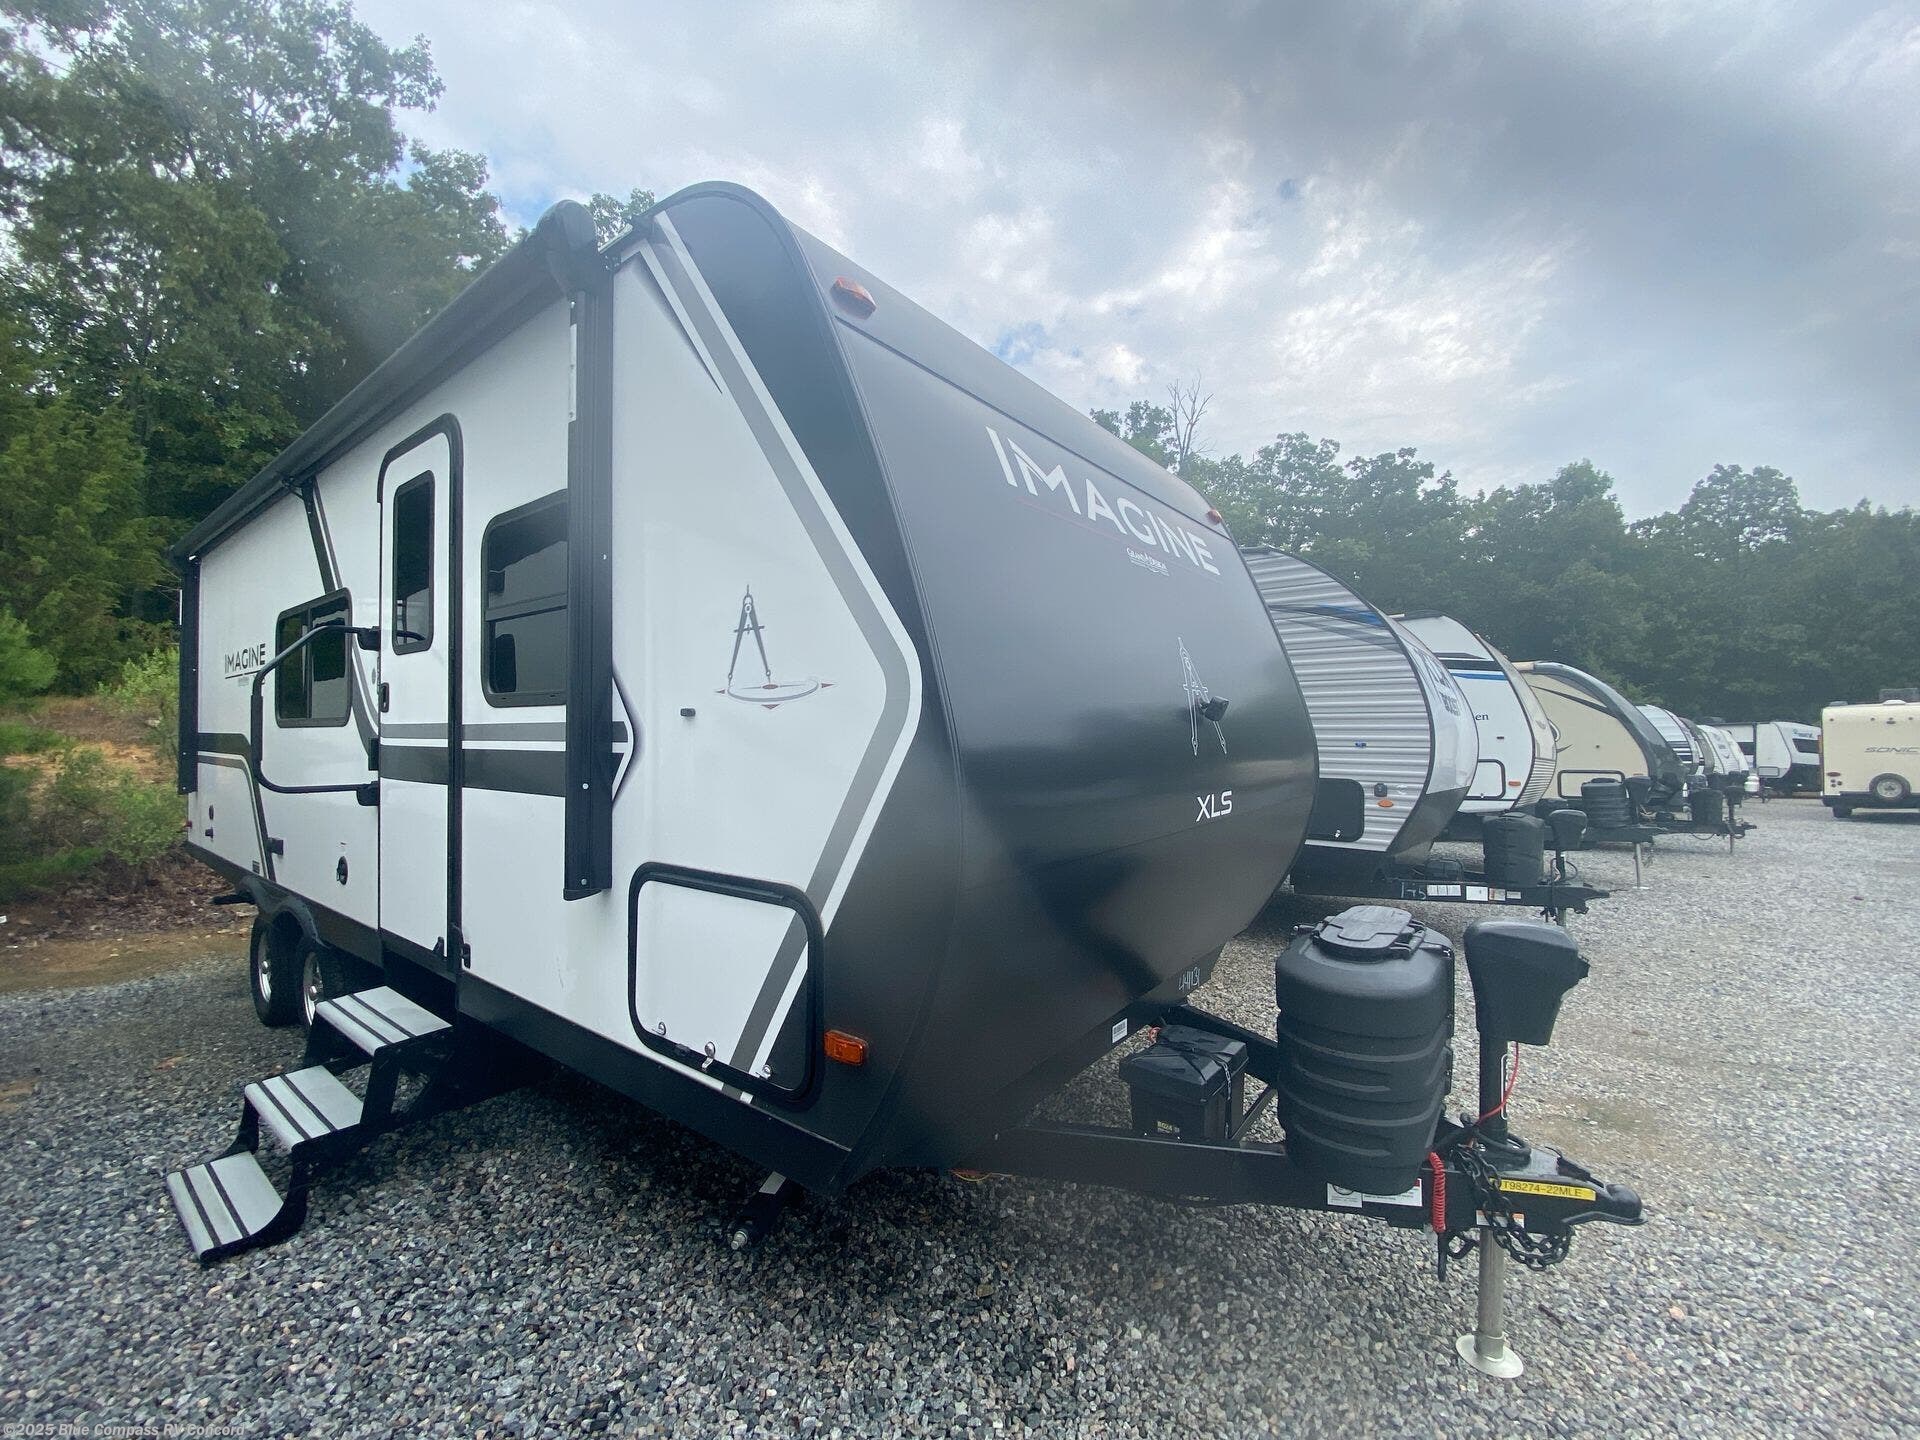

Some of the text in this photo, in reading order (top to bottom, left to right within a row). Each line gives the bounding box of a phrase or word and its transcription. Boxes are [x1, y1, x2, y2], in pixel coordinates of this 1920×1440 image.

[985, 426, 1221, 576] IMAGINE
[224, 643, 266, 674] IMAGINE
[1196, 790, 1232, 822] XLS
